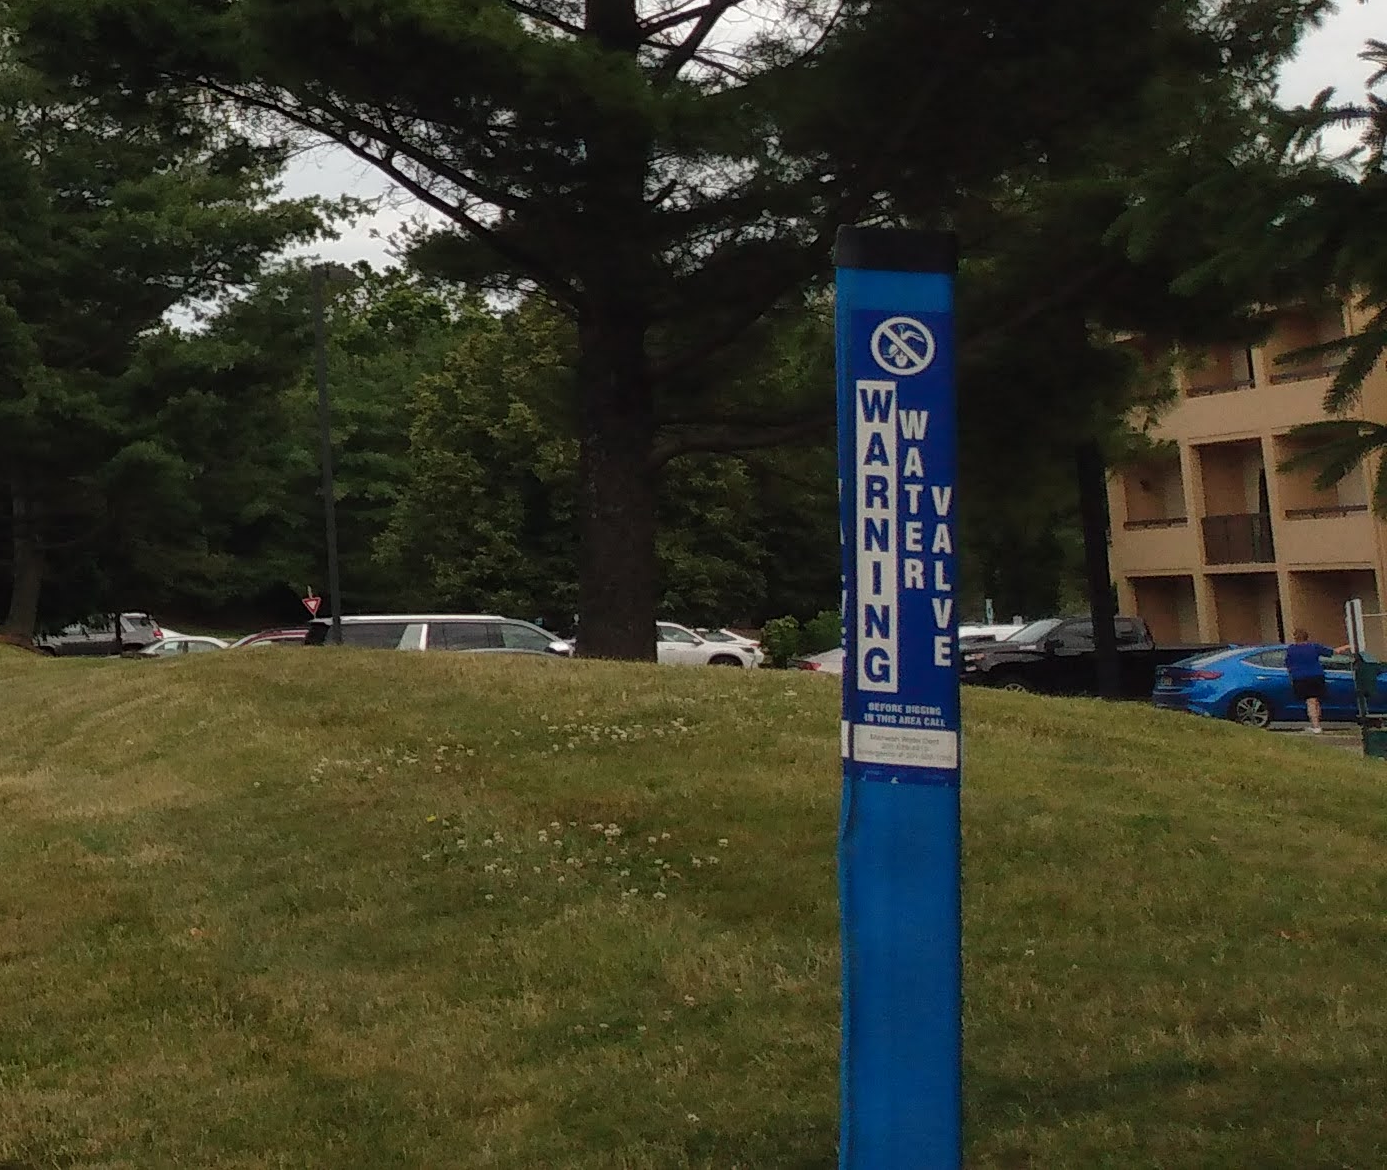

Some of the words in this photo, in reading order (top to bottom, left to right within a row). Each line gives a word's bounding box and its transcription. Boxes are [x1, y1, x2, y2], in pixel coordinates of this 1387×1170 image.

[859, 389, 894, 683] WARNING
[898, 409, 929, 590] WATER
[931, 485, 953, 667] VALVE
[864, 713, 875, 722] IN
[876, 714, 897, 724] THIS
[898, 715, 922, 726] AREA
[868, 702, 903, 713] BEFORE
[905, 704, 942, 716] DIGGING
